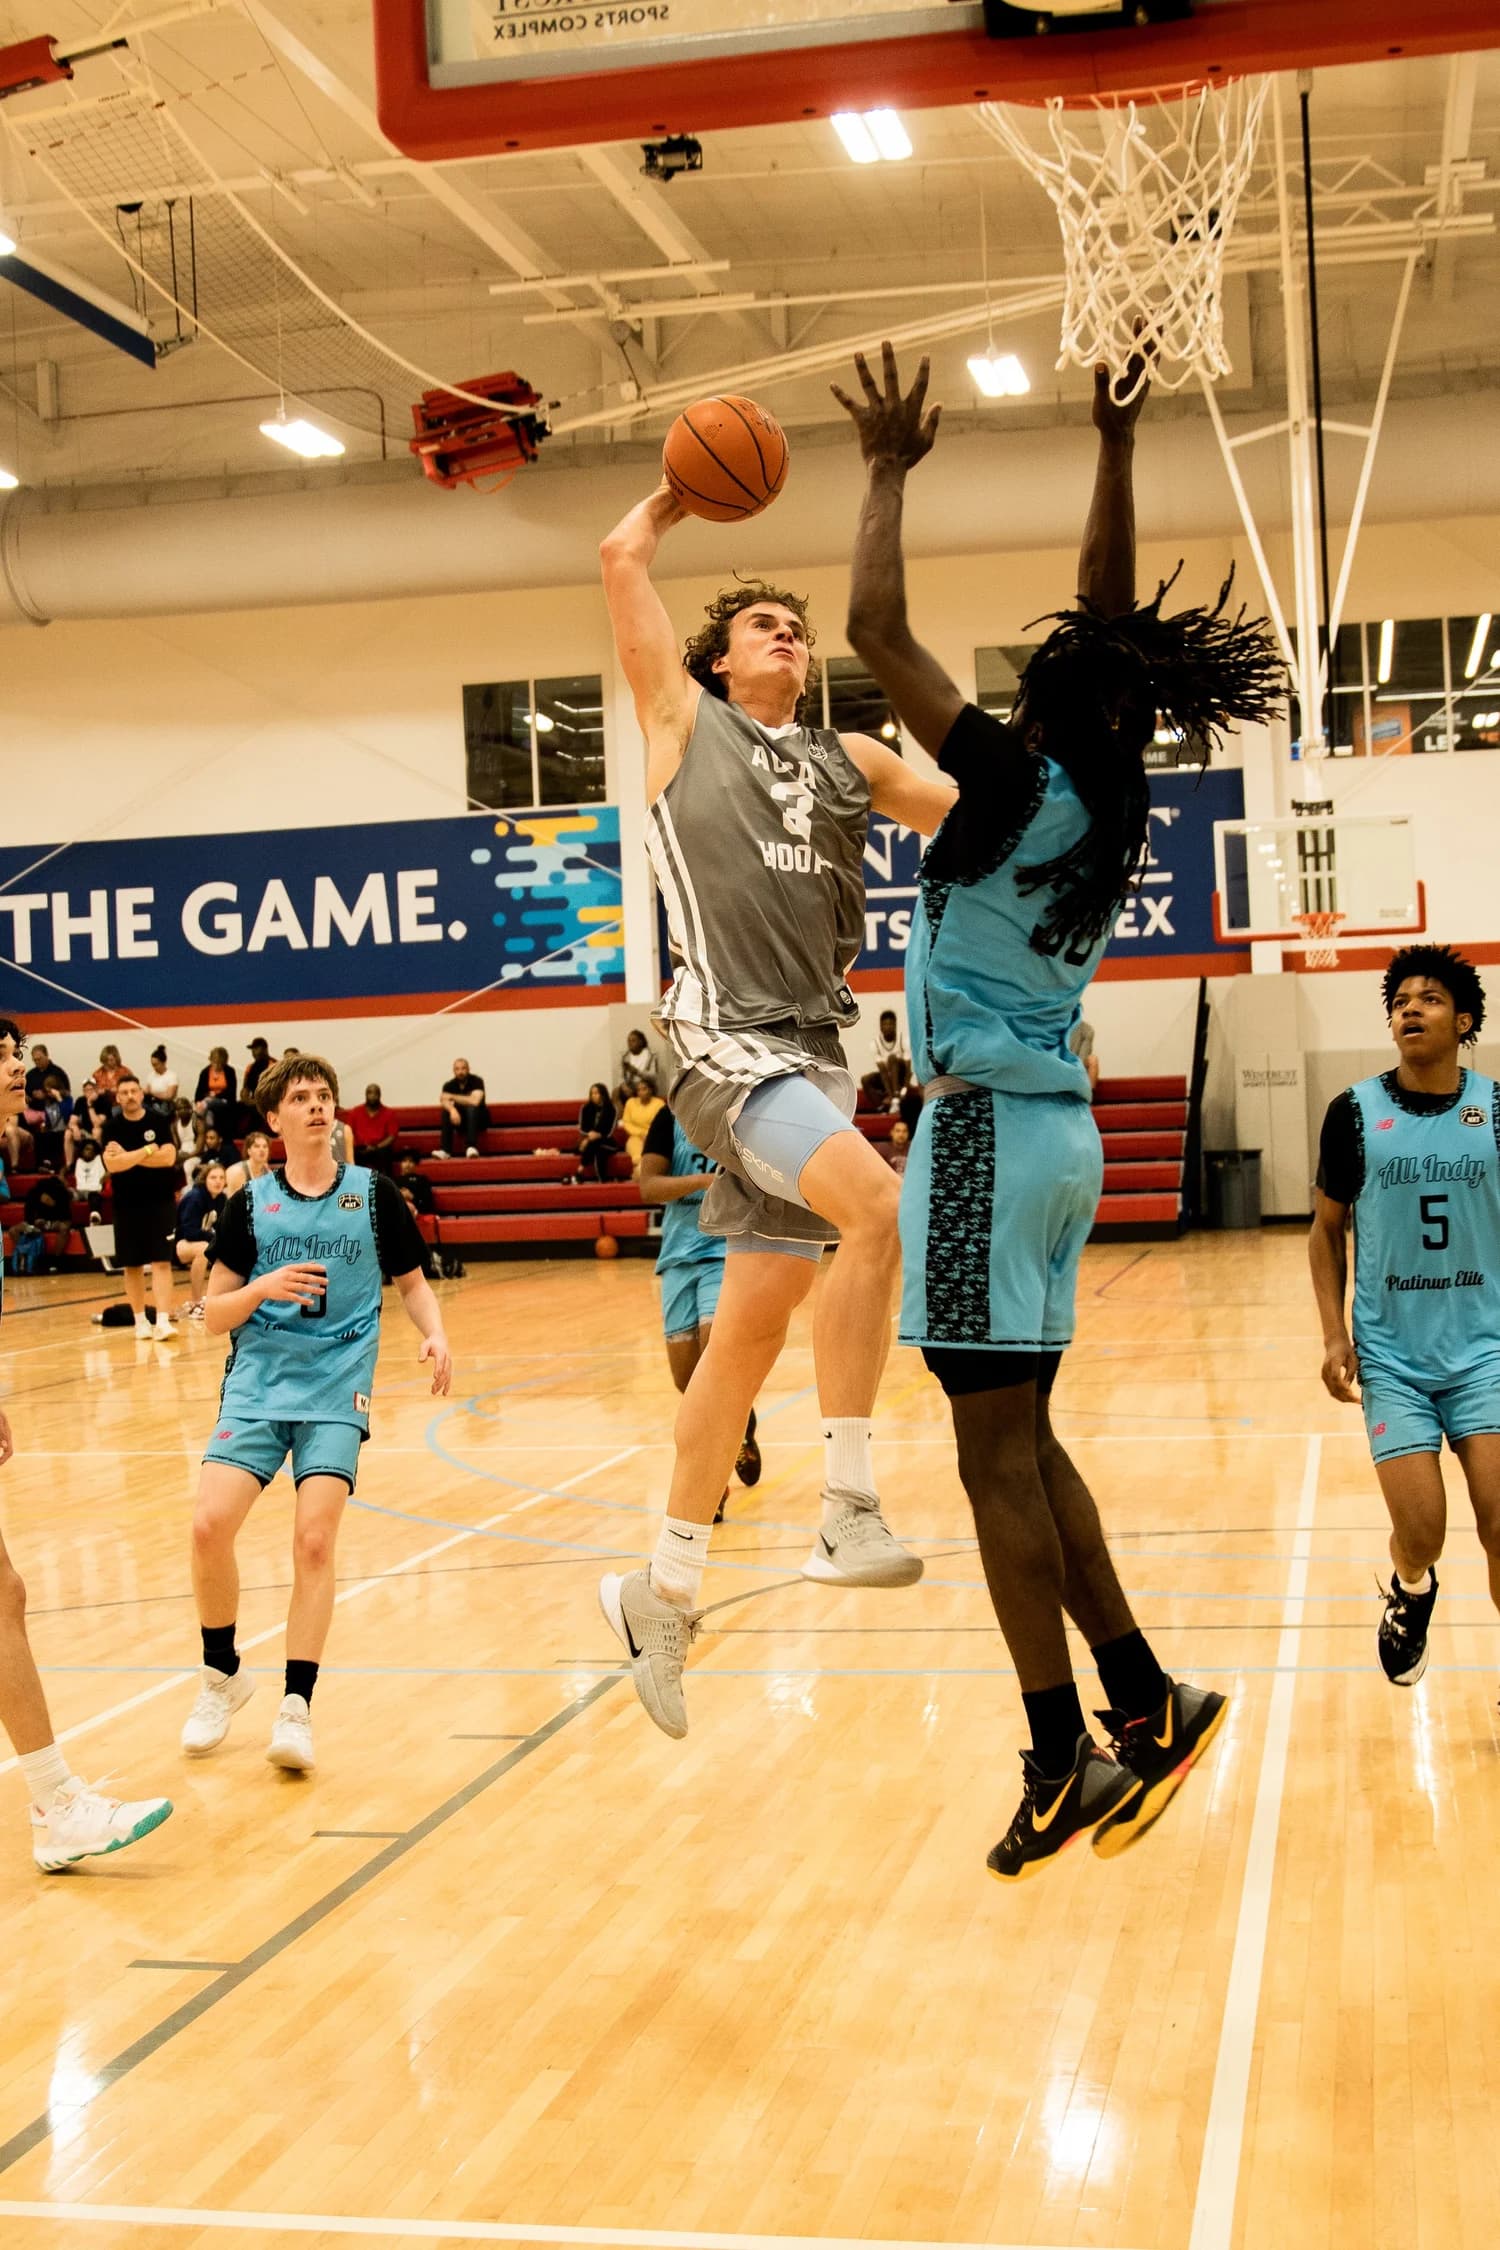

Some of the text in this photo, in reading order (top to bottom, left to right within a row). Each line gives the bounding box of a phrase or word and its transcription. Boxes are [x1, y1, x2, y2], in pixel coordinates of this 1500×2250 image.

[770, 781, 814, 845] 3
[0, 868, 467, 964] THE GAME.
[1379, 1154, 1486, 1189] All Indy
[266, 1234, 362, 1265] All Indy
[1419, 1194, 1449, 1250] 5
